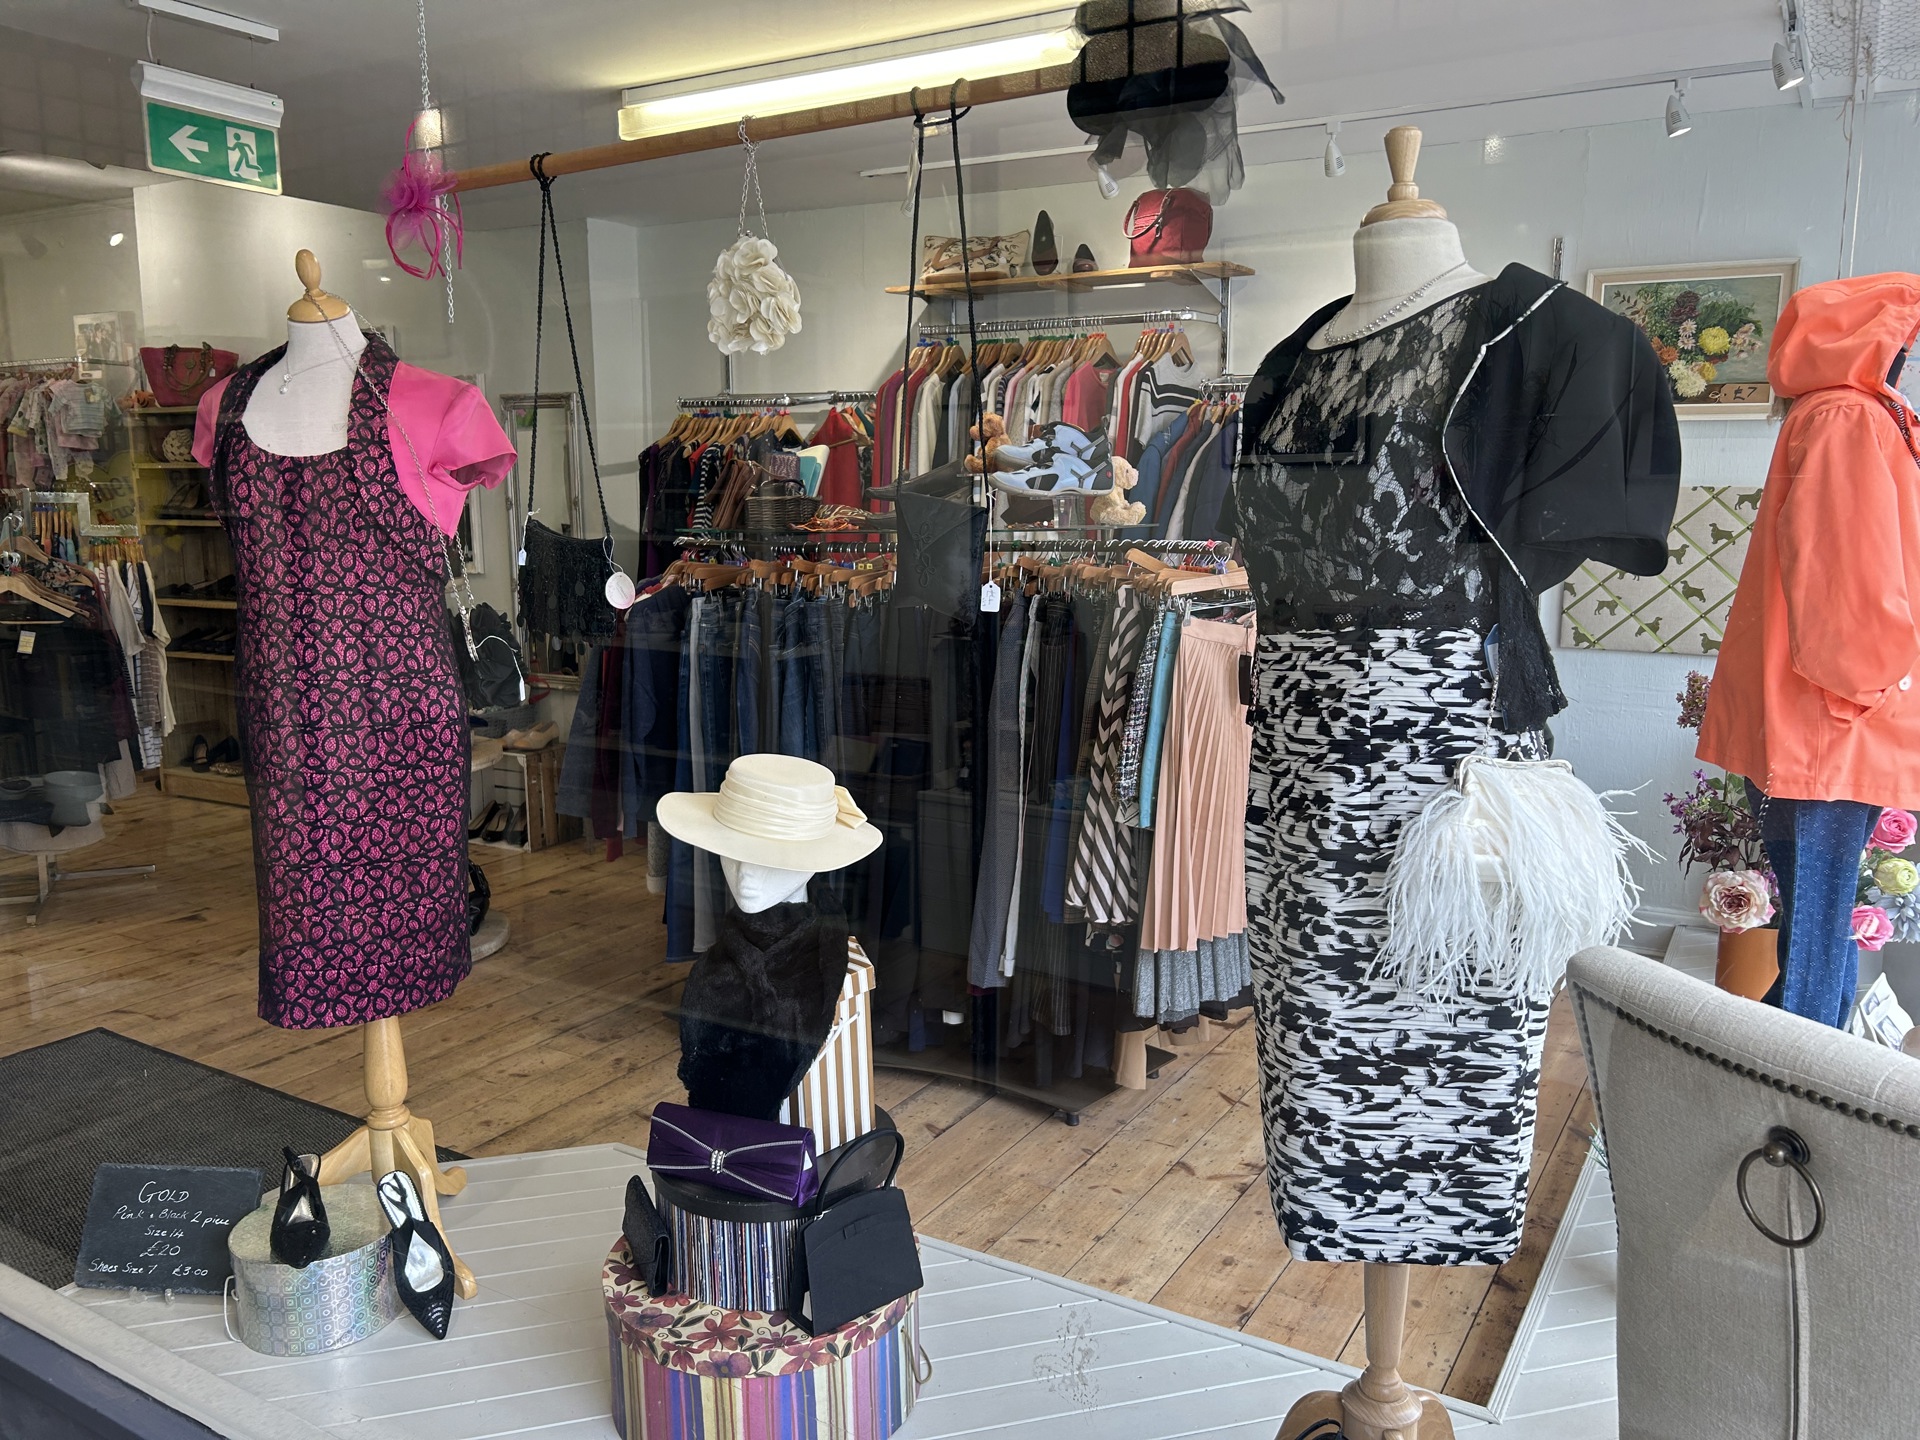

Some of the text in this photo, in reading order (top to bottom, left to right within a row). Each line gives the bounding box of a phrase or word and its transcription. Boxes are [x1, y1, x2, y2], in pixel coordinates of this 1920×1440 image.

[1733, 386, 1757, 400] £7
[138, 1181, 190, 1203] GOLD
[112, 1205, 145, 1219] Pink
[158, 1208, 189, 1219] Black
[190, 1210, 203, 1223] 2
[144, 1224, 184, 1238] Size 14
[139, 1240, 181, 1257] £20
[88, 1258, 119, 1273] Shoes
[122, 1262, 144, 1274] Size
[148, 1264, 158, 1274] 7
